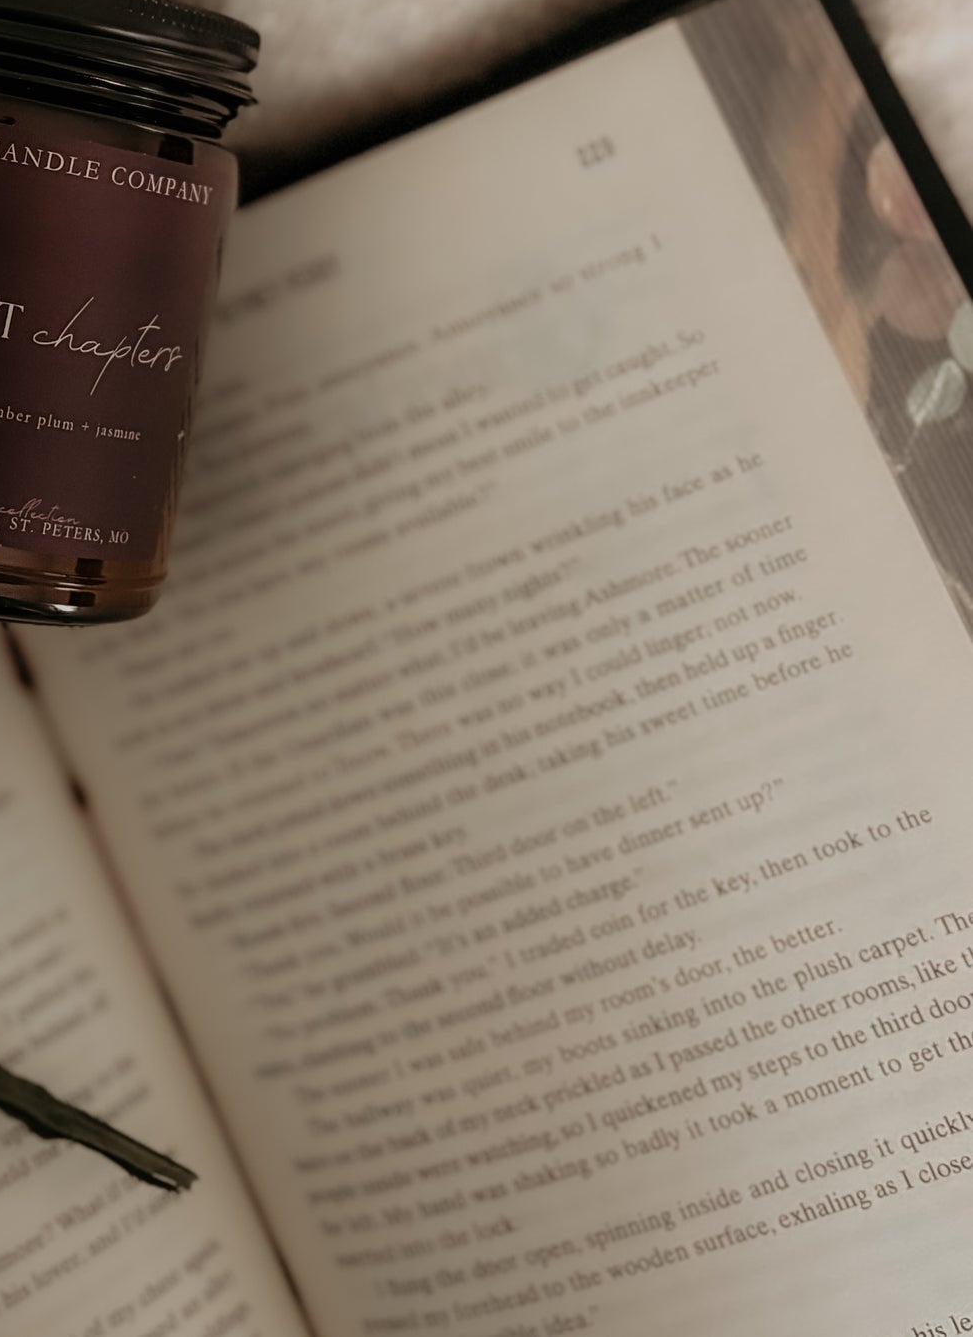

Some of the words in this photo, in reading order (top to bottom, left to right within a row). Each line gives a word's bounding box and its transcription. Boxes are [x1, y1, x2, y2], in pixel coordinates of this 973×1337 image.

[112, 167, 213, 205] COMPANY
[33, 297, 183, 396] chapters
[37, 414, 73, 431] plum
[94, 426, 141, 440] jasmine
[9, 516, 34, 533] ST.
[42, 521, 104, 544] PETERS,
[109, 529, 130, 544] MO
[724, 516, 793, 552] sooner
[758, 549, 807, 576] time
[751, 656, 823, 690] before
[824, 644, 853, 664] he
[689, 802, 732, 828] sent
[637, 901, 668, 923] for
[674, 889, 708, 909] the
[712, 873, 757, 896] key,
[759, 853, 808, 879] then
[812, 831, 863, 861] took
[867, 824, 891, 841] to
[896, 810, 932, 831] the
[675, 960, 731, 986] door,
[732, 946, 767, 967] the
[770, 921, 842, 953] better.
[703, 992, 746, 1016] into
[751, 978, 787, 999] the
[793, 952, 853, 991] plush
[859, 927, 934, 963] carpet.
[669, 1029, 739, 1072] passed
[741, 1021, 777, 1043] the
[781, 999, 837, 1029] other
[841, 976, 916, 1010] rooms,
[914, 959, 957, 984] like
[602, 1077, 707, 1130] quickened
[711, 1071, 742, 1092] my
[747, 1051, 802, 1080] steps
[804, 1043, 828, 1061] to
[831, 1030, 868, 1053] the
[870, 1004, 926, 1038] third
[929, 993, 973, 1019] doo
[622, 1129, 679, 1158] badly
[687, 1122, 704, 1139] it
[709, 1103, 758, 1131] took
[765, 1100, 779, 1114] a
[783, 1065, 874, 1108] moment
[878, 1059, 902, 1077] to
[909, 1042, 944, 1072] get
[586, 1211, 675, 1250] spinning
[679, 1188, 742, 1220] inside
[749, 1169, 789, 1199] and
[795, 1149, 874, 1183] closing
[874, 1139, 895, 1158] it
[607, 1246, 689, 1279] wooden
[693, 1221, 777, 1255] surface,
[779, 1190, 872, 1228] exhaling
[874, 1180, 898, 1198] as
[899, 1170, 914, 1190] I
